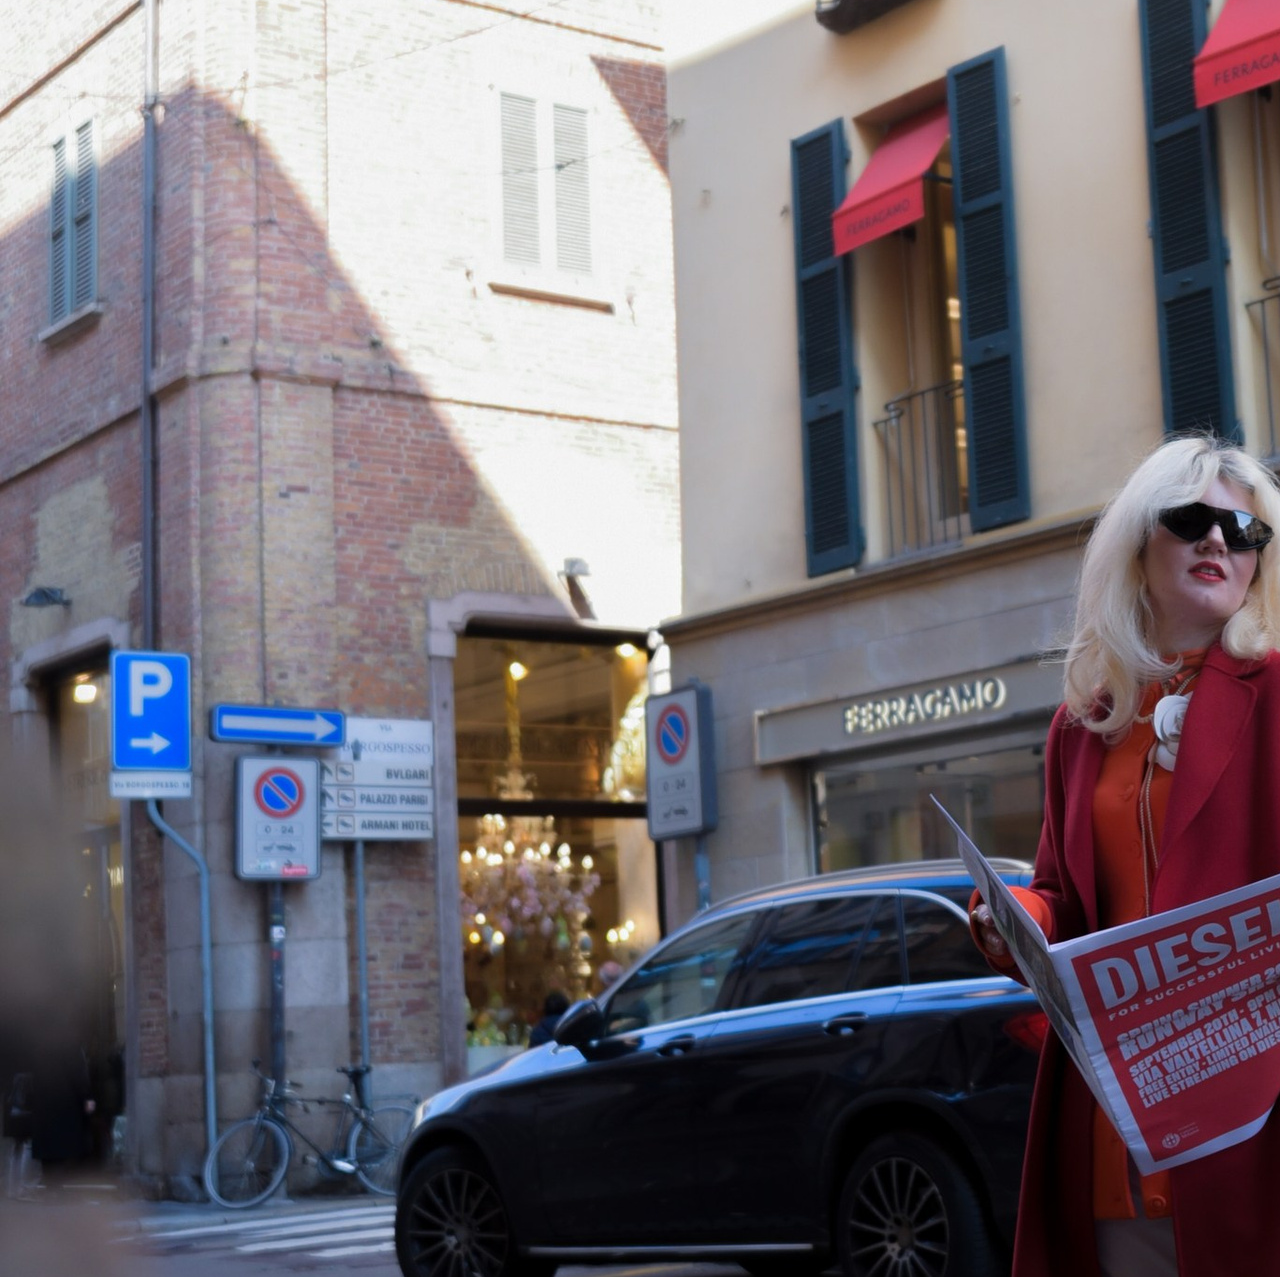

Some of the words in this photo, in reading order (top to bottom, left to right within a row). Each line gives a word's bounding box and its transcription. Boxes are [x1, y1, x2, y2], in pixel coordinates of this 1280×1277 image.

[130, 660, 173, 716] P
[844, 677, 1006, 734] FERRAGAMO
[360, 793, 398, 805] PALAZZO
[386, 768, 429, 780] BVLGARI
[361, 819, 399, 831] ARMANI
[402, 820, 432, 831] HOTEL
[1108, 1003, 1140, 1021] FOR
[1144, 958, 1246, 1006] SUCCESSFUL
[1118, 997, 1225, 1061] RUNWAY
[1128, 1027, 1205, 1077] SEPTEMBER
[1203, 1008, 1239, 1036] 20TH
[1132, 1065, 1163, 1089] VIA
[1162, 1018, 1253, 1073] VALTELLINA
[1138, 1080, 1166, 1098] FREE
[1165, 1061, 1200, 1085] ENTRY
[1206, 1036, 1250, 1065] LIMITED
[1142, 1085, 1170, 1109] LIVE
[1171, 1054, 1239, 1095] STREAMING
[1239, 1046, 1257, 1062] ON
